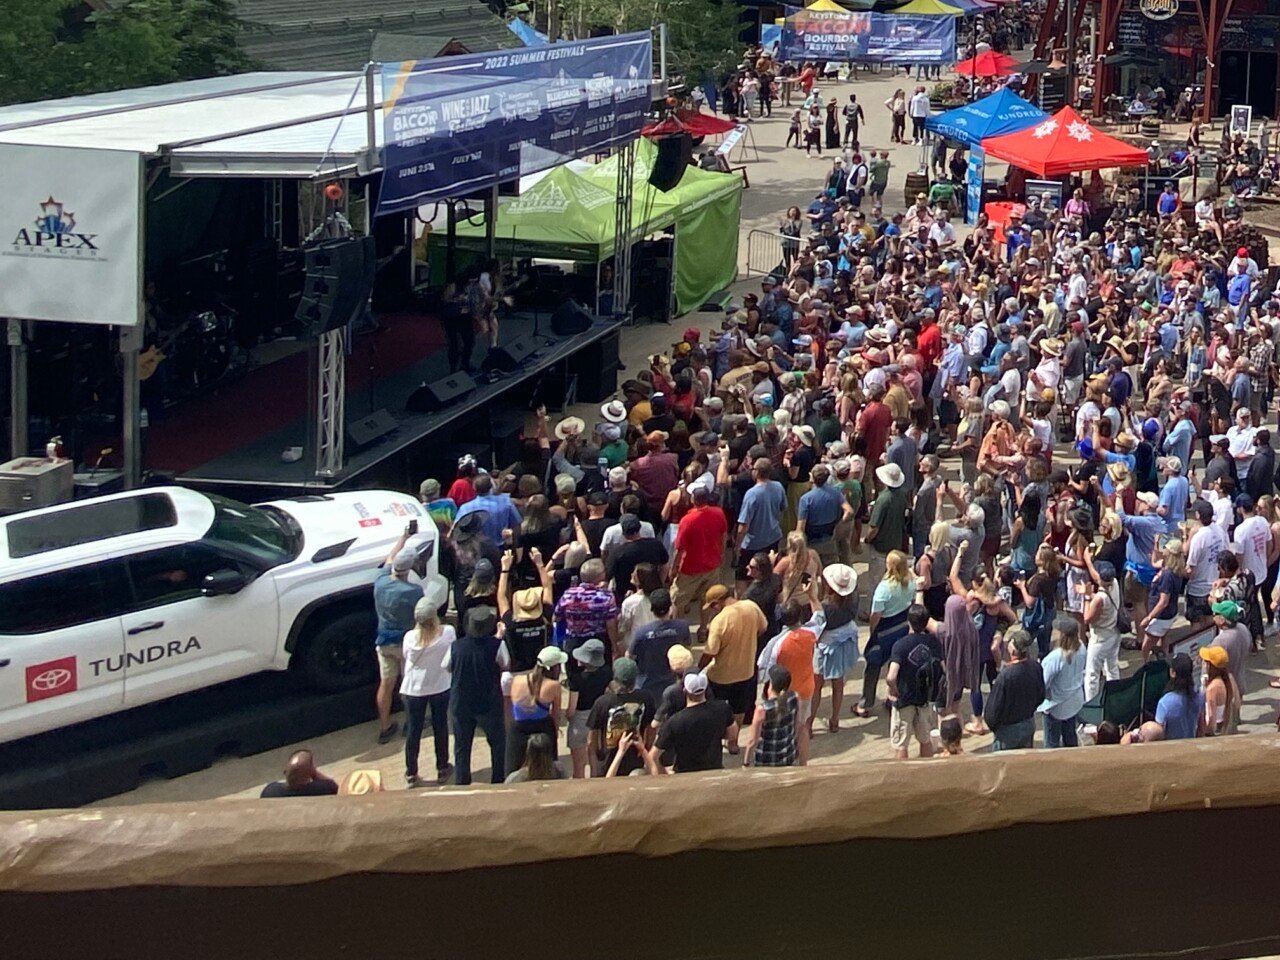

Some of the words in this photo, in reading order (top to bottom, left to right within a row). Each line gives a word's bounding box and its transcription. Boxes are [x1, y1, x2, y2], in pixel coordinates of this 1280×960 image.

[809, 11, 851, 20] KEYSTONE
[804, 34, 858, 44] BOURBON
[804, 43, 847, 51] FESTIVAL
[485, 56, 507, 70] 2022
[509, 50, 546, 66] SUMMER
[547, 45, 586, 61] FESTIVALS
[441, 100, 466, 122] WINE
[470, 95, 490, 117] JAZZ
[998, 110, 1043, 121] KINDRED
[393, 110, 438, 131] BACON
[936, 124, 969, 141] KINDRED
[452, 155, 471, 164] JULY
[12, 228, 100, 250] APEX
[14, 246, 97, 257] STAGES
[89, 636, 202, 677] TUNDRA
